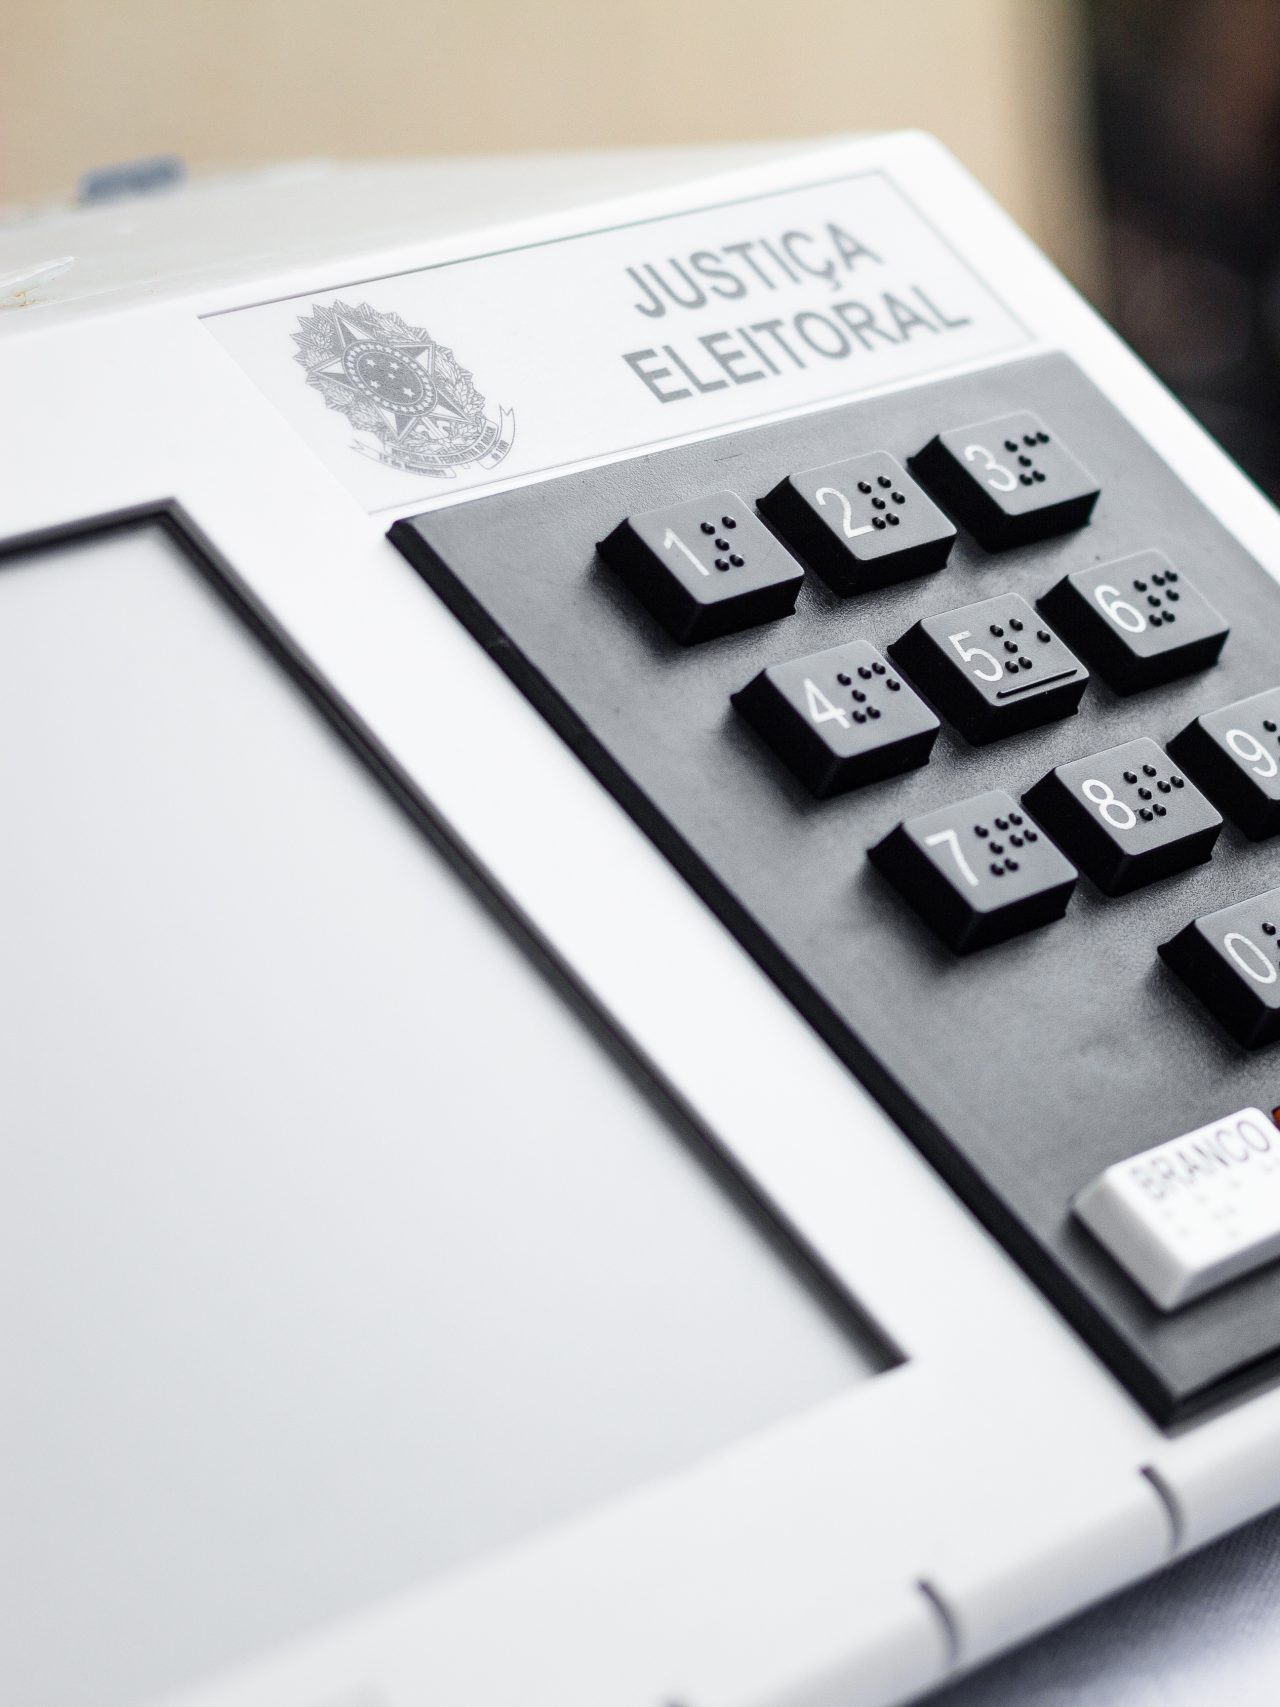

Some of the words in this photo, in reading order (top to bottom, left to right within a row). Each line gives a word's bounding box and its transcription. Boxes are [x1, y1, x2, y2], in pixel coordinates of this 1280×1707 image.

[625, 222, 885, 318] JUSTIÇA
[621, 285, 972, 404] ELEITORAL
[964, 444, 1019, 493] 3
[815, 487, 875, 540] 2
[664, 528, 710, 577] 1
[1093, 583, 1148, 633] 6
[948, 630, 1004, 682] 5
[803, 678, 851, 730] 4
[1225, 729, 1278, 778] 9
[1082, 779, 1138, 830] 8
[924, 829, 980, 887] 7
[1224, 932, 1278, 985] 0
[1131, 1120, 1271, 1200] BRANCO
